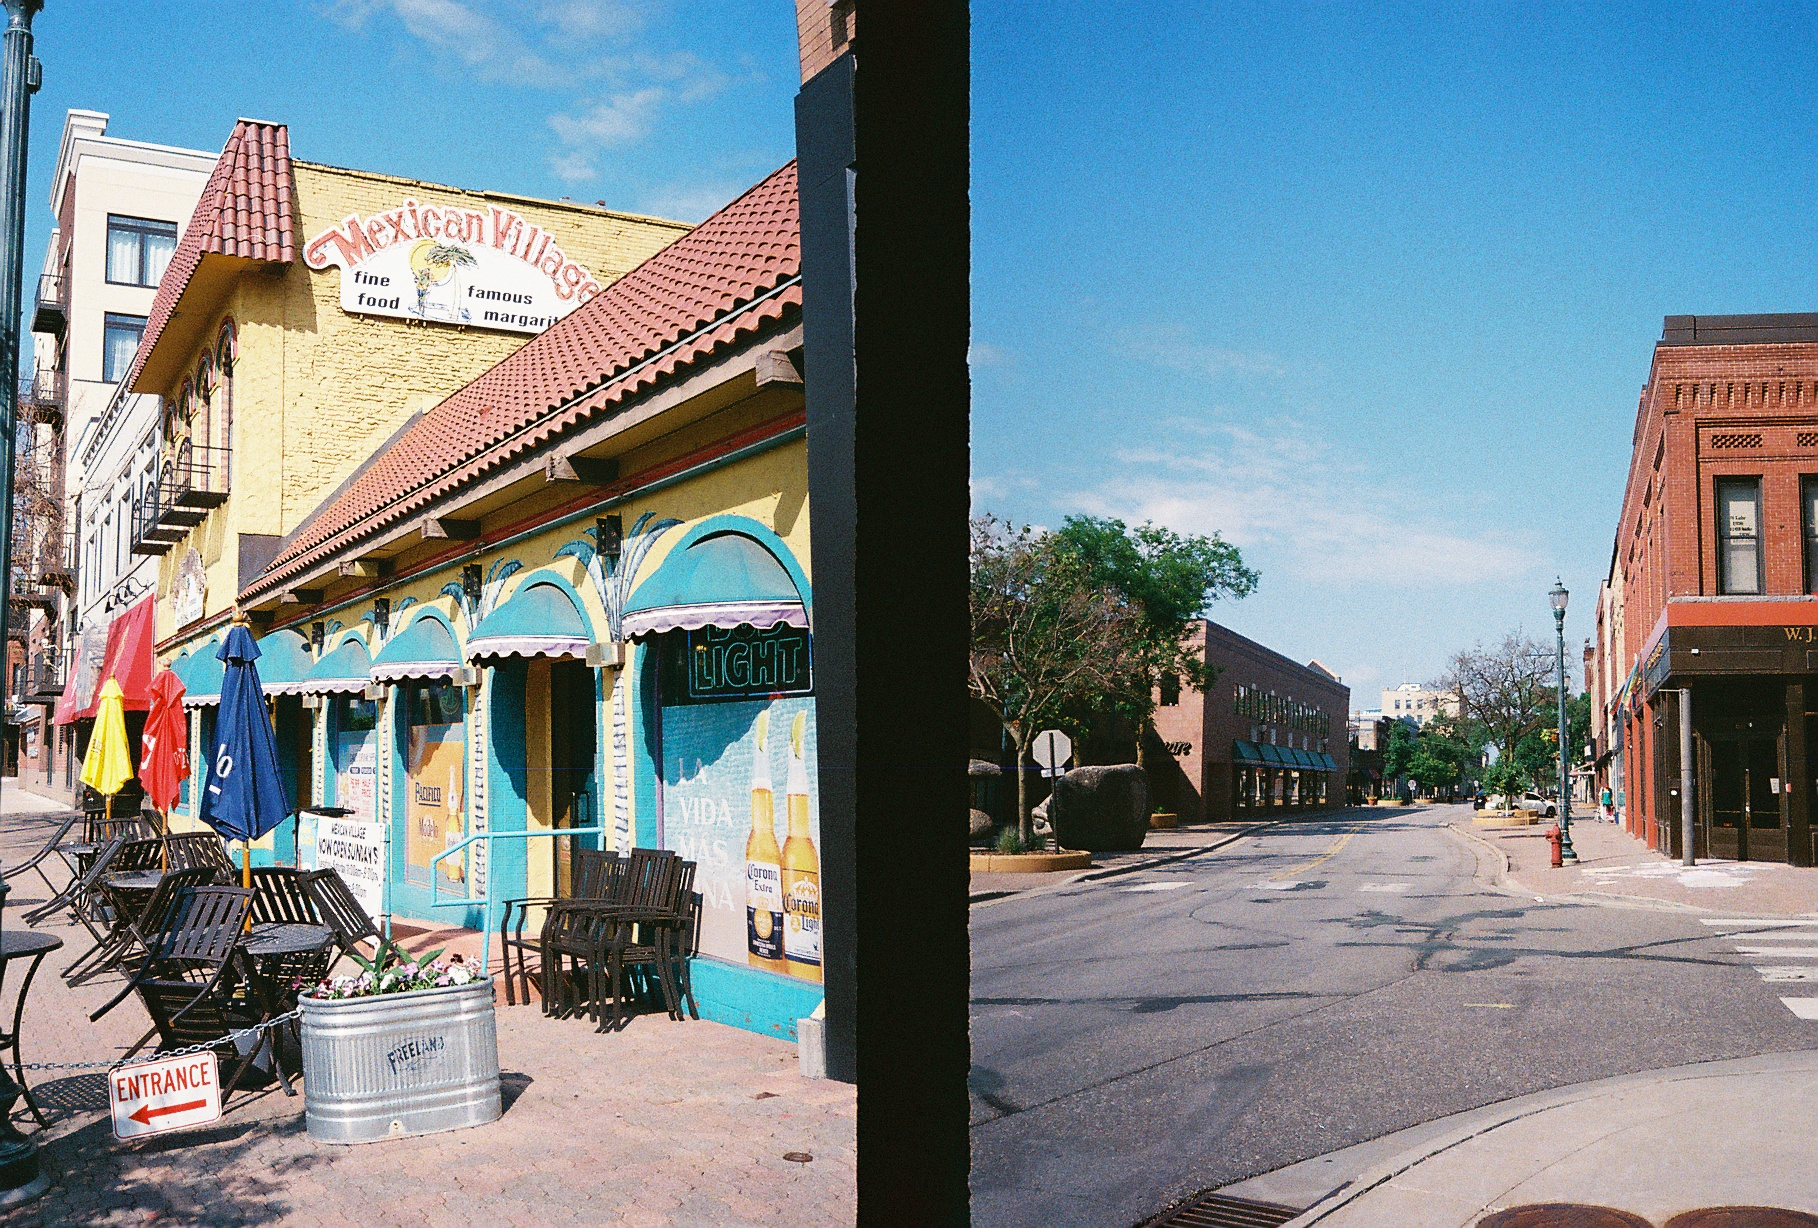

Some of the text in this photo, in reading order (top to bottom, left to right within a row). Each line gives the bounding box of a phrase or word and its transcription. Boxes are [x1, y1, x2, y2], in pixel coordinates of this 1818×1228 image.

[306, 200, 600, 304] Mexican Village
[353, 271, 390, 287] fine
[357, 292, 400, 310] food
[468, 285, 534, 305] famous
[1784, 627, 1802, 640] W.
[694, 637, 803, 690] LIGHT
[679, 757, 708, 785] LA
[680, 796, 734, 828] VIDA
[318, 837, 379, 865] NOW OPEN SUNDAYS
[748, 863, 778, 881] Corona
[754, 879, 773, 893] Extra
[783, 893, 819, 916] Corona
[117, 1061, 211, 1103] ENTRANCE
